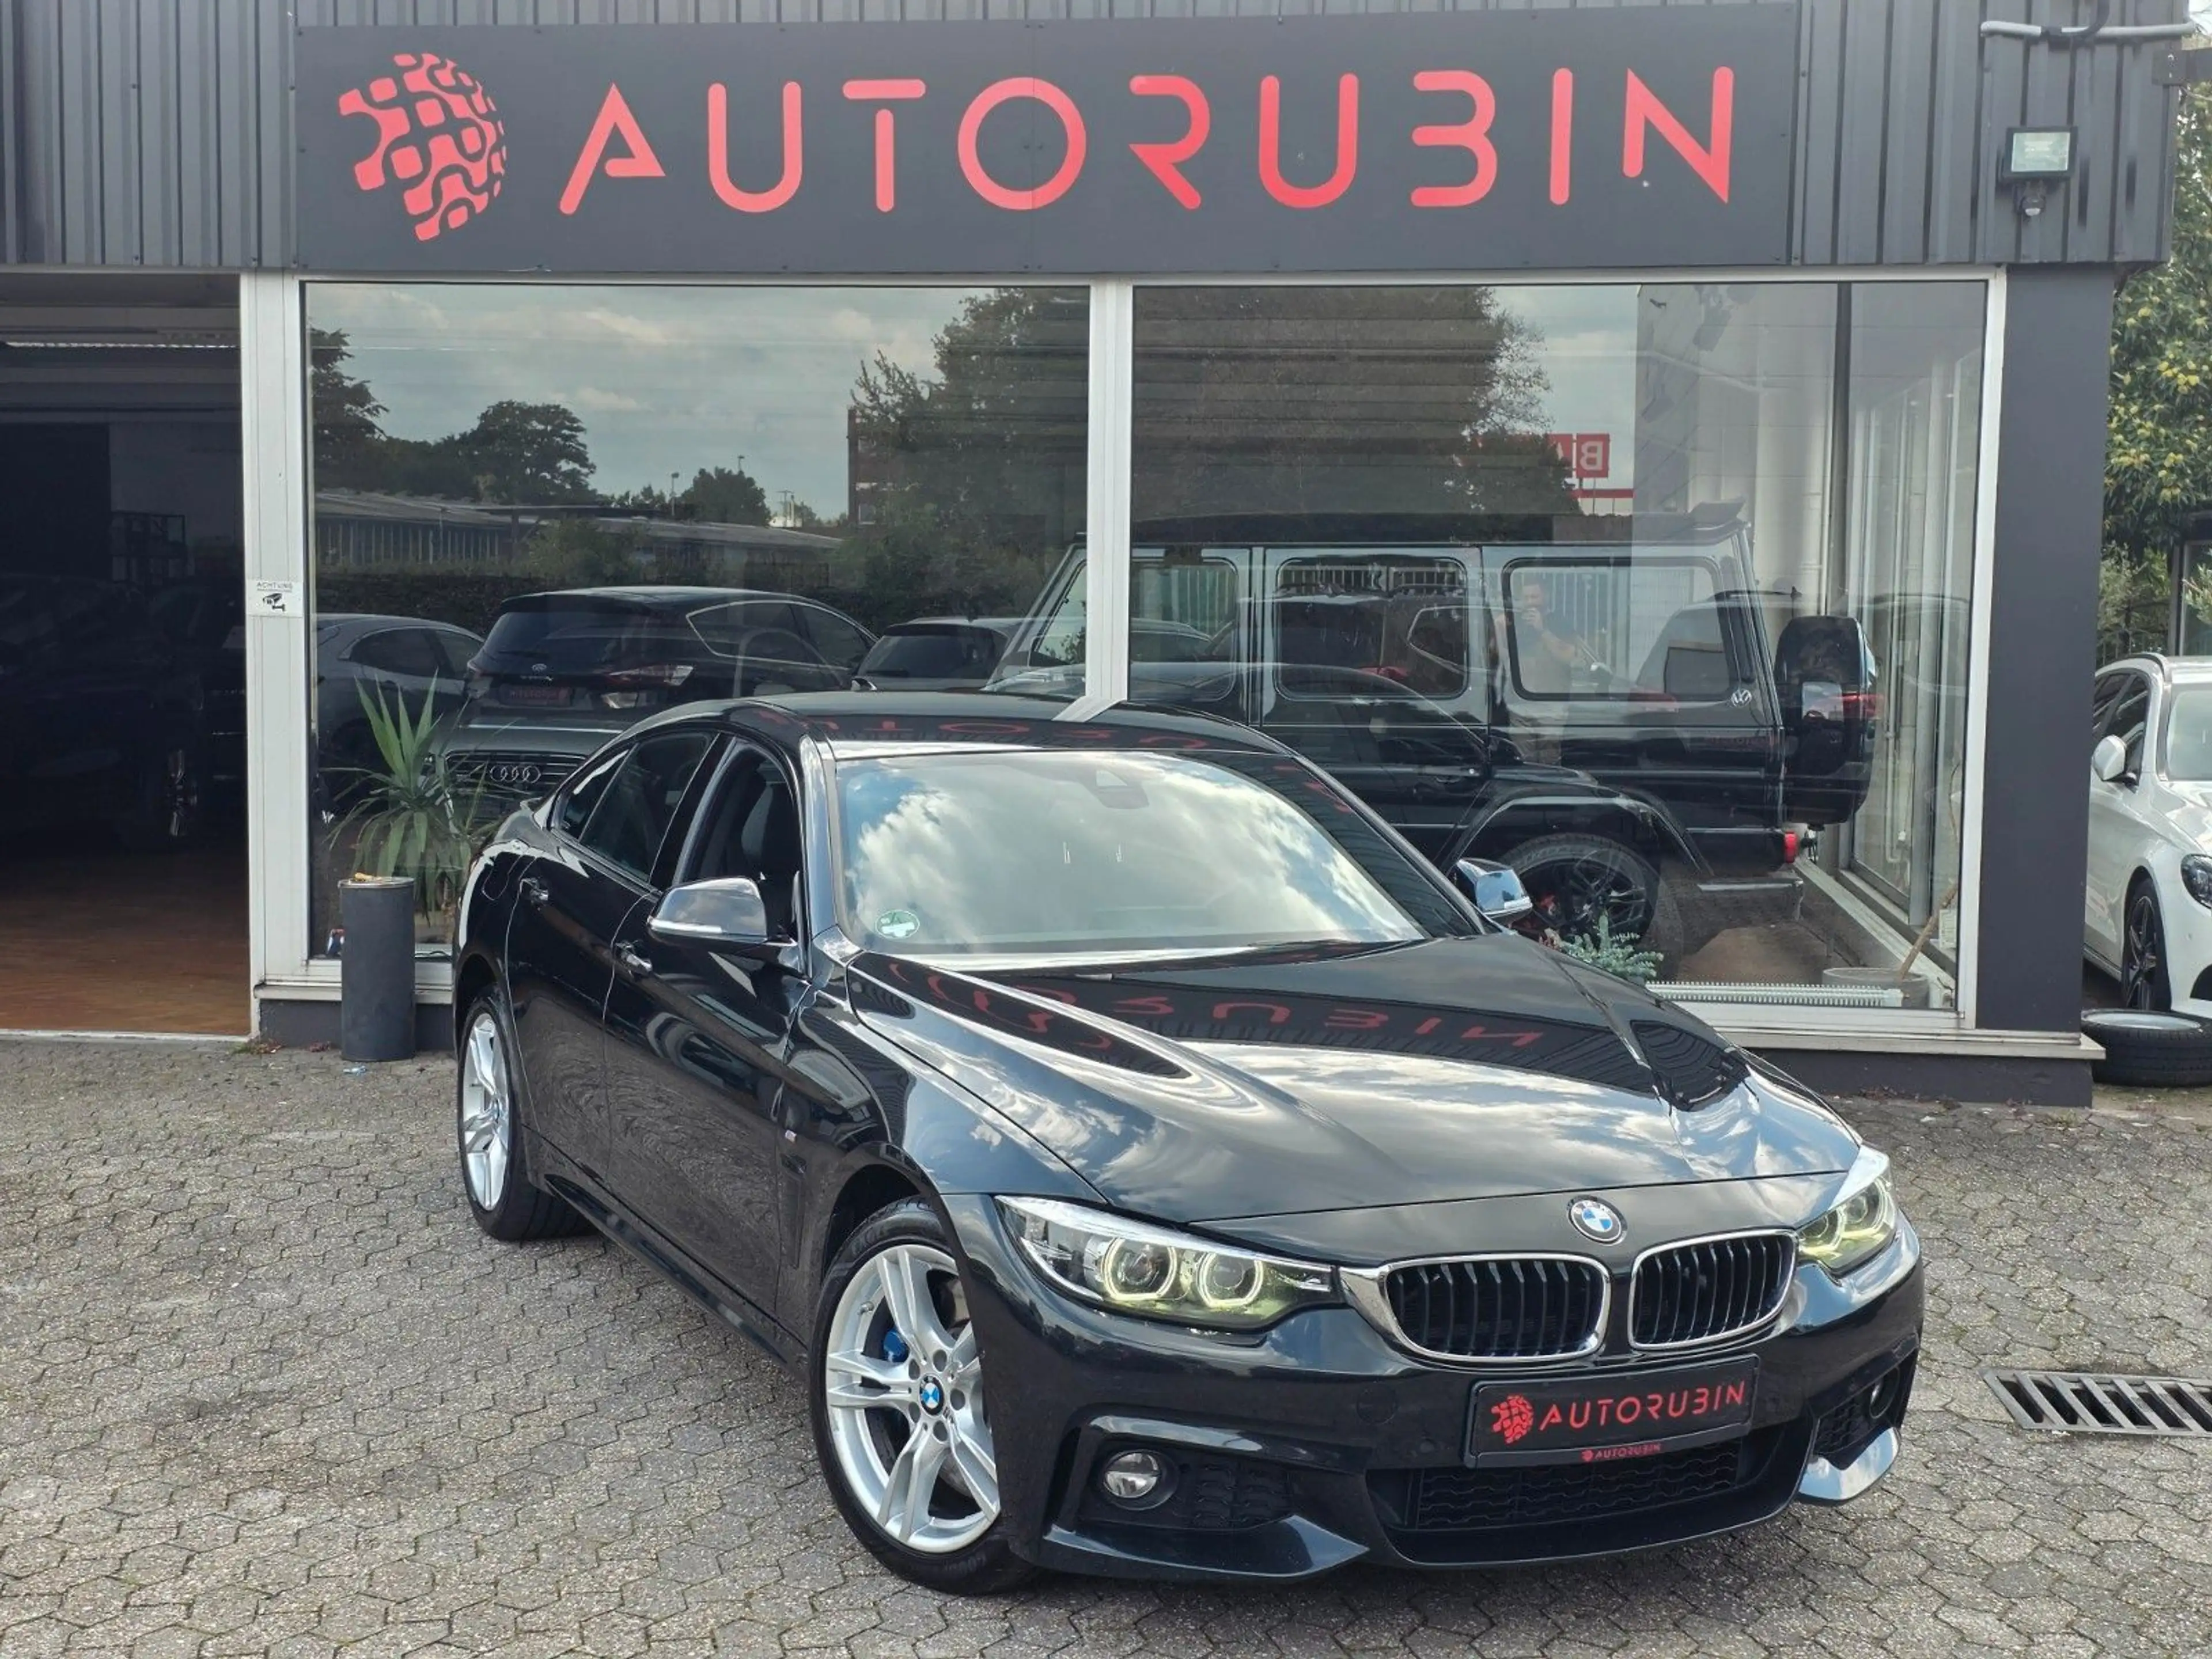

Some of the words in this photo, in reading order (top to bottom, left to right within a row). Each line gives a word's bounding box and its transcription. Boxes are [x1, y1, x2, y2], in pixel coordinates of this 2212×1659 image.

[559, 66, 1733, 214] AUTORUBIN
[1539, 1380, 1745, 1431] AUTORUBIN
[1594, 1442, 1662, 1460] AUTORUBIN
